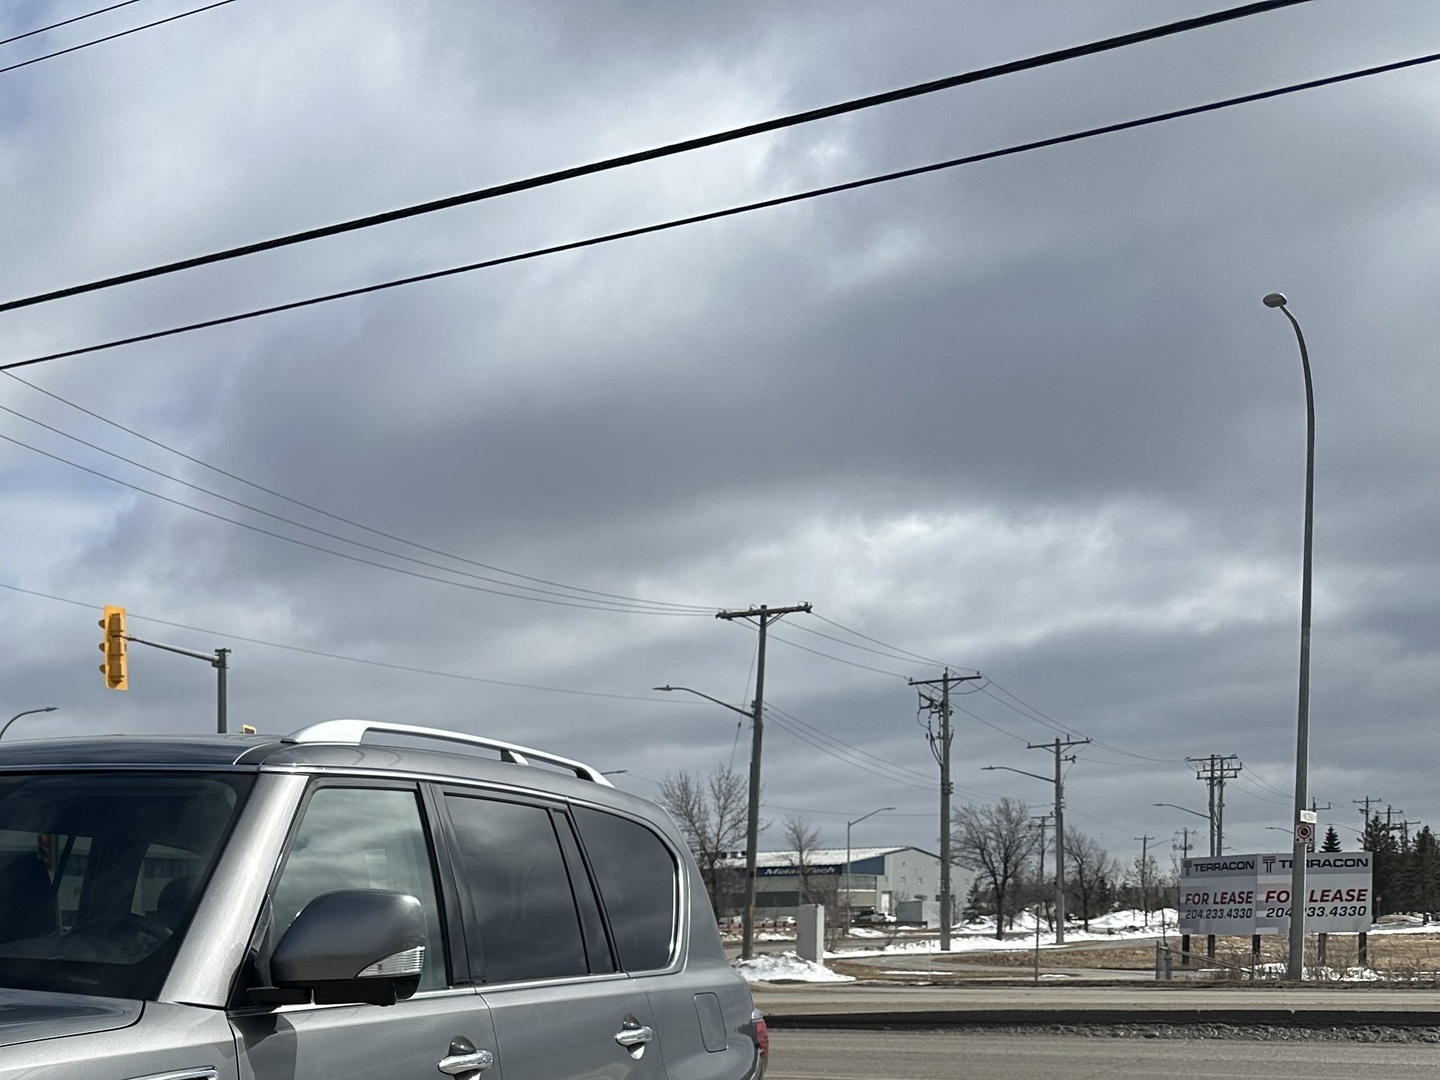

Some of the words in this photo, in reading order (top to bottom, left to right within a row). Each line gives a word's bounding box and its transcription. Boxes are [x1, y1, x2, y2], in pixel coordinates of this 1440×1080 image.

[1193, 860, 1254, 872] TERRACON
[1185, 892, 1210, 905] FOR
[1213, 891, 1254, 905] LEASE
[1265, 890, 1290, 903] FO
[1309, 889, 1368, 903] LEASE
[1186, 908, 1253, 919] 204.233.4330
[1266, 906, 1367, 918] 20433.4330
